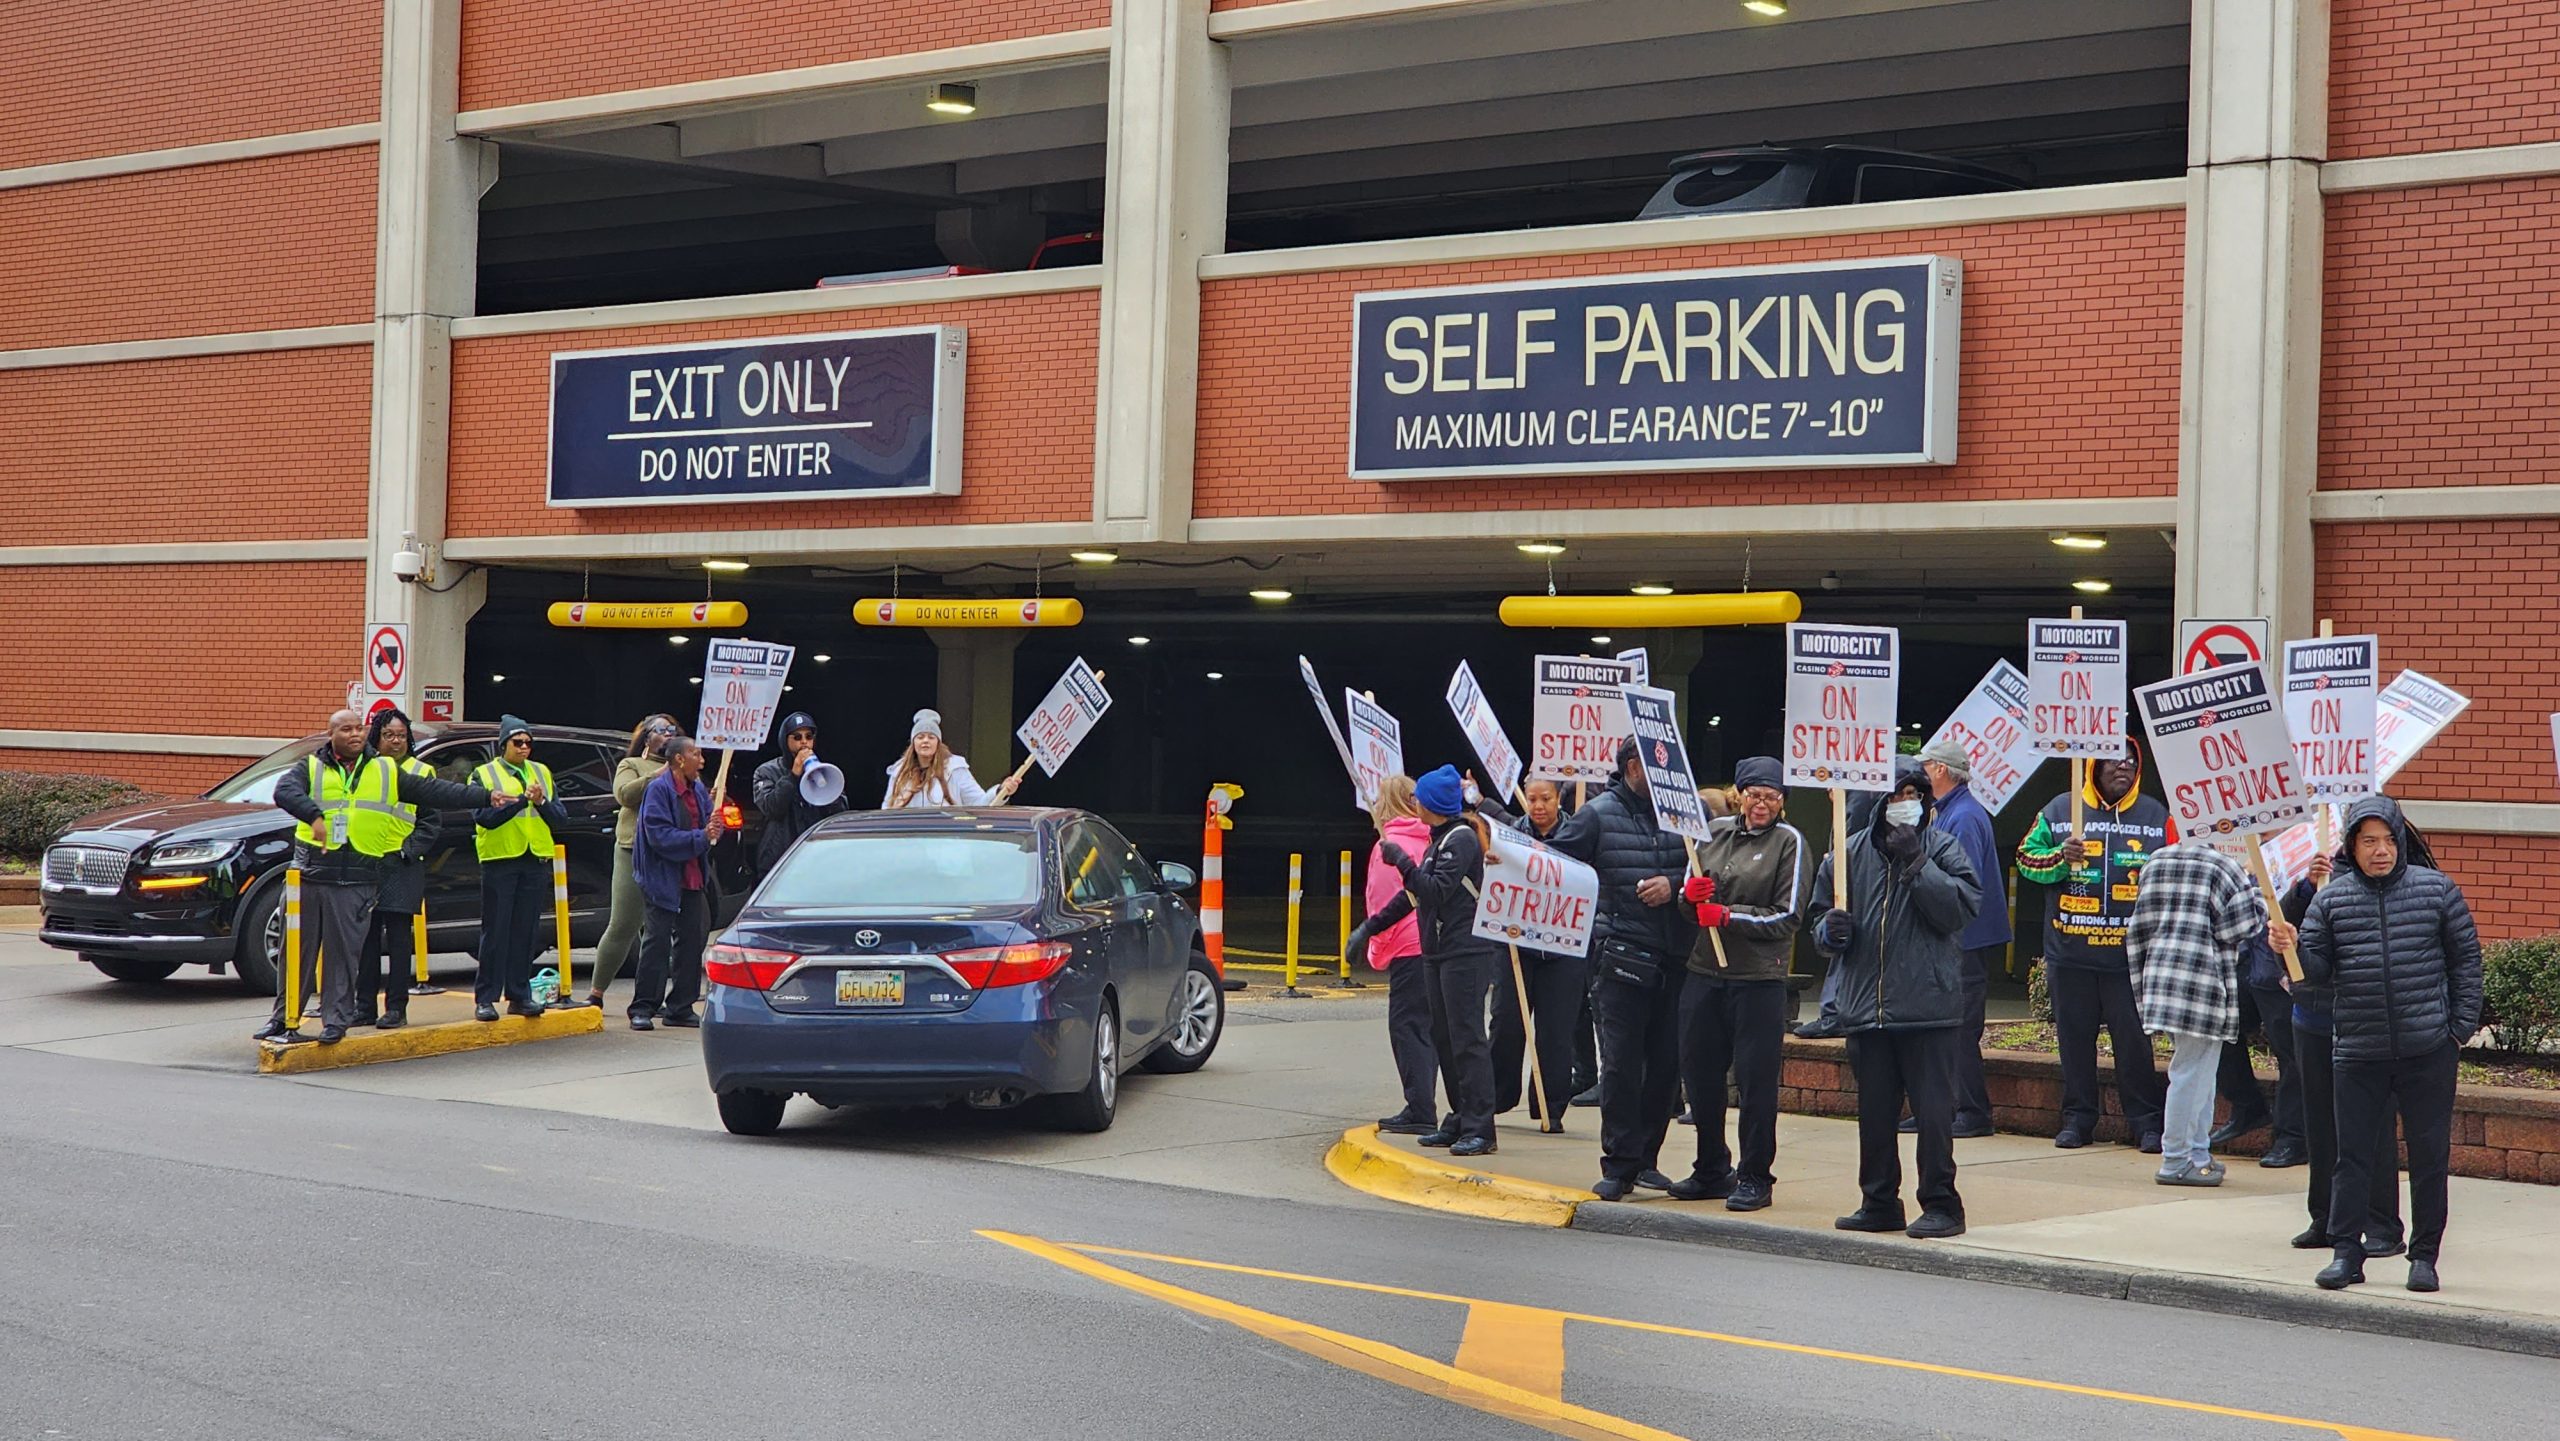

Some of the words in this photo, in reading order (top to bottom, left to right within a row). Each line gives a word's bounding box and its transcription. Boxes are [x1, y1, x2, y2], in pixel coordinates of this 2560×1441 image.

[1384, 308, 1556, 395] SELF
[1585, 288, 1905, 386] PARKING
[629, 364, 725, 422] EXIT
[738, 356, 851, 417] ONLY
[1395, 410, 1556, 450] MAXIMUM
[1566, 402, 1772, 445] CLEARANCE
[640, 448, 677, 482] DO
[686, 445, 740, 480] NOT
[747, 441, 832, 478] ENTER
[602, 607, 616, 619] DO
[618, 607, 637, 619] NOT
[641, 606, 674, 619] ENTER
[916, 607, 931, 619] DO
[935, 607, 958, 619] NOT
[962, 607, 998, 619] ENTER
[1801, 634, 1882, 656] MOTORCITY
[2041, 627, 2113, 645] MOTORCITY
[717, 645, 765, 663] MOTORCITY
[2295, 646, 2364, 669] MOTORCITY
[1549, 663, 1624, 683] MOTORCITY
[1796, 664, 1826, 673] CASINO
[1846, 667, 1889, 676] WORKERS
[2290, 682, 2315, 690] CASINO
[2331, 677, 2369, 687] WORKERS
[424, 690, 453, 700] NOTICE
[725, 680, 748, 705] ON
[1073, 667, 1105, 709] MOTORCITY
[1543, 687, 1573, 695] CASINO
[1985, 687, 2009, 709] CASINO
[2061, 670, 2092, 700] ON
[2155, 673, 2252, 713] MOTORCITY
[1057, 703, 1079, 730] ON
[1636, 699, 1660, 719] DON'T
[1823, 684, 1857, 721] ON
[2311, 698, 2341, 735] ON
[703, 706, 760, 732] STRIKE
[1569, 703, 1602, 731] ON
[1634, 716, 1676, 744] GAMBLE
[2034, 704, 2119, 735] STRIKE
[2158, 719, 2196, 734] CASINO
[2219, 702, 2270, 720] WORKERS
[1031, 709, 1072, 759] STRIKE
[1792, 724, 1888, 764] STRIKE
[1983, 716, 2021, 754] ON
[1942, 720, 2021, 796] STRIKE
[2199, 729, 2248, 772] ON
[1648, 766, 1669, 785] WITH
[1670, 772, 1690, 790] OUR
[2175, 761, 2298, 820] STRIKE
[1654, 786, 1697, 815] FUTURE
[2084, 822, 2141, 836] APOLOGIZE
[2143, 826, 2164, 838] FOR
[1526, 853, 1563, 888] ON
[1486, 880, 1590, 932] STRIKE
[2071, 914, 2107, 926] STRONG
[2109, 916, 2121, 926] BE
[2087, 935, 2122, 946] BLACK
[874, 981, 896, 998] 732
